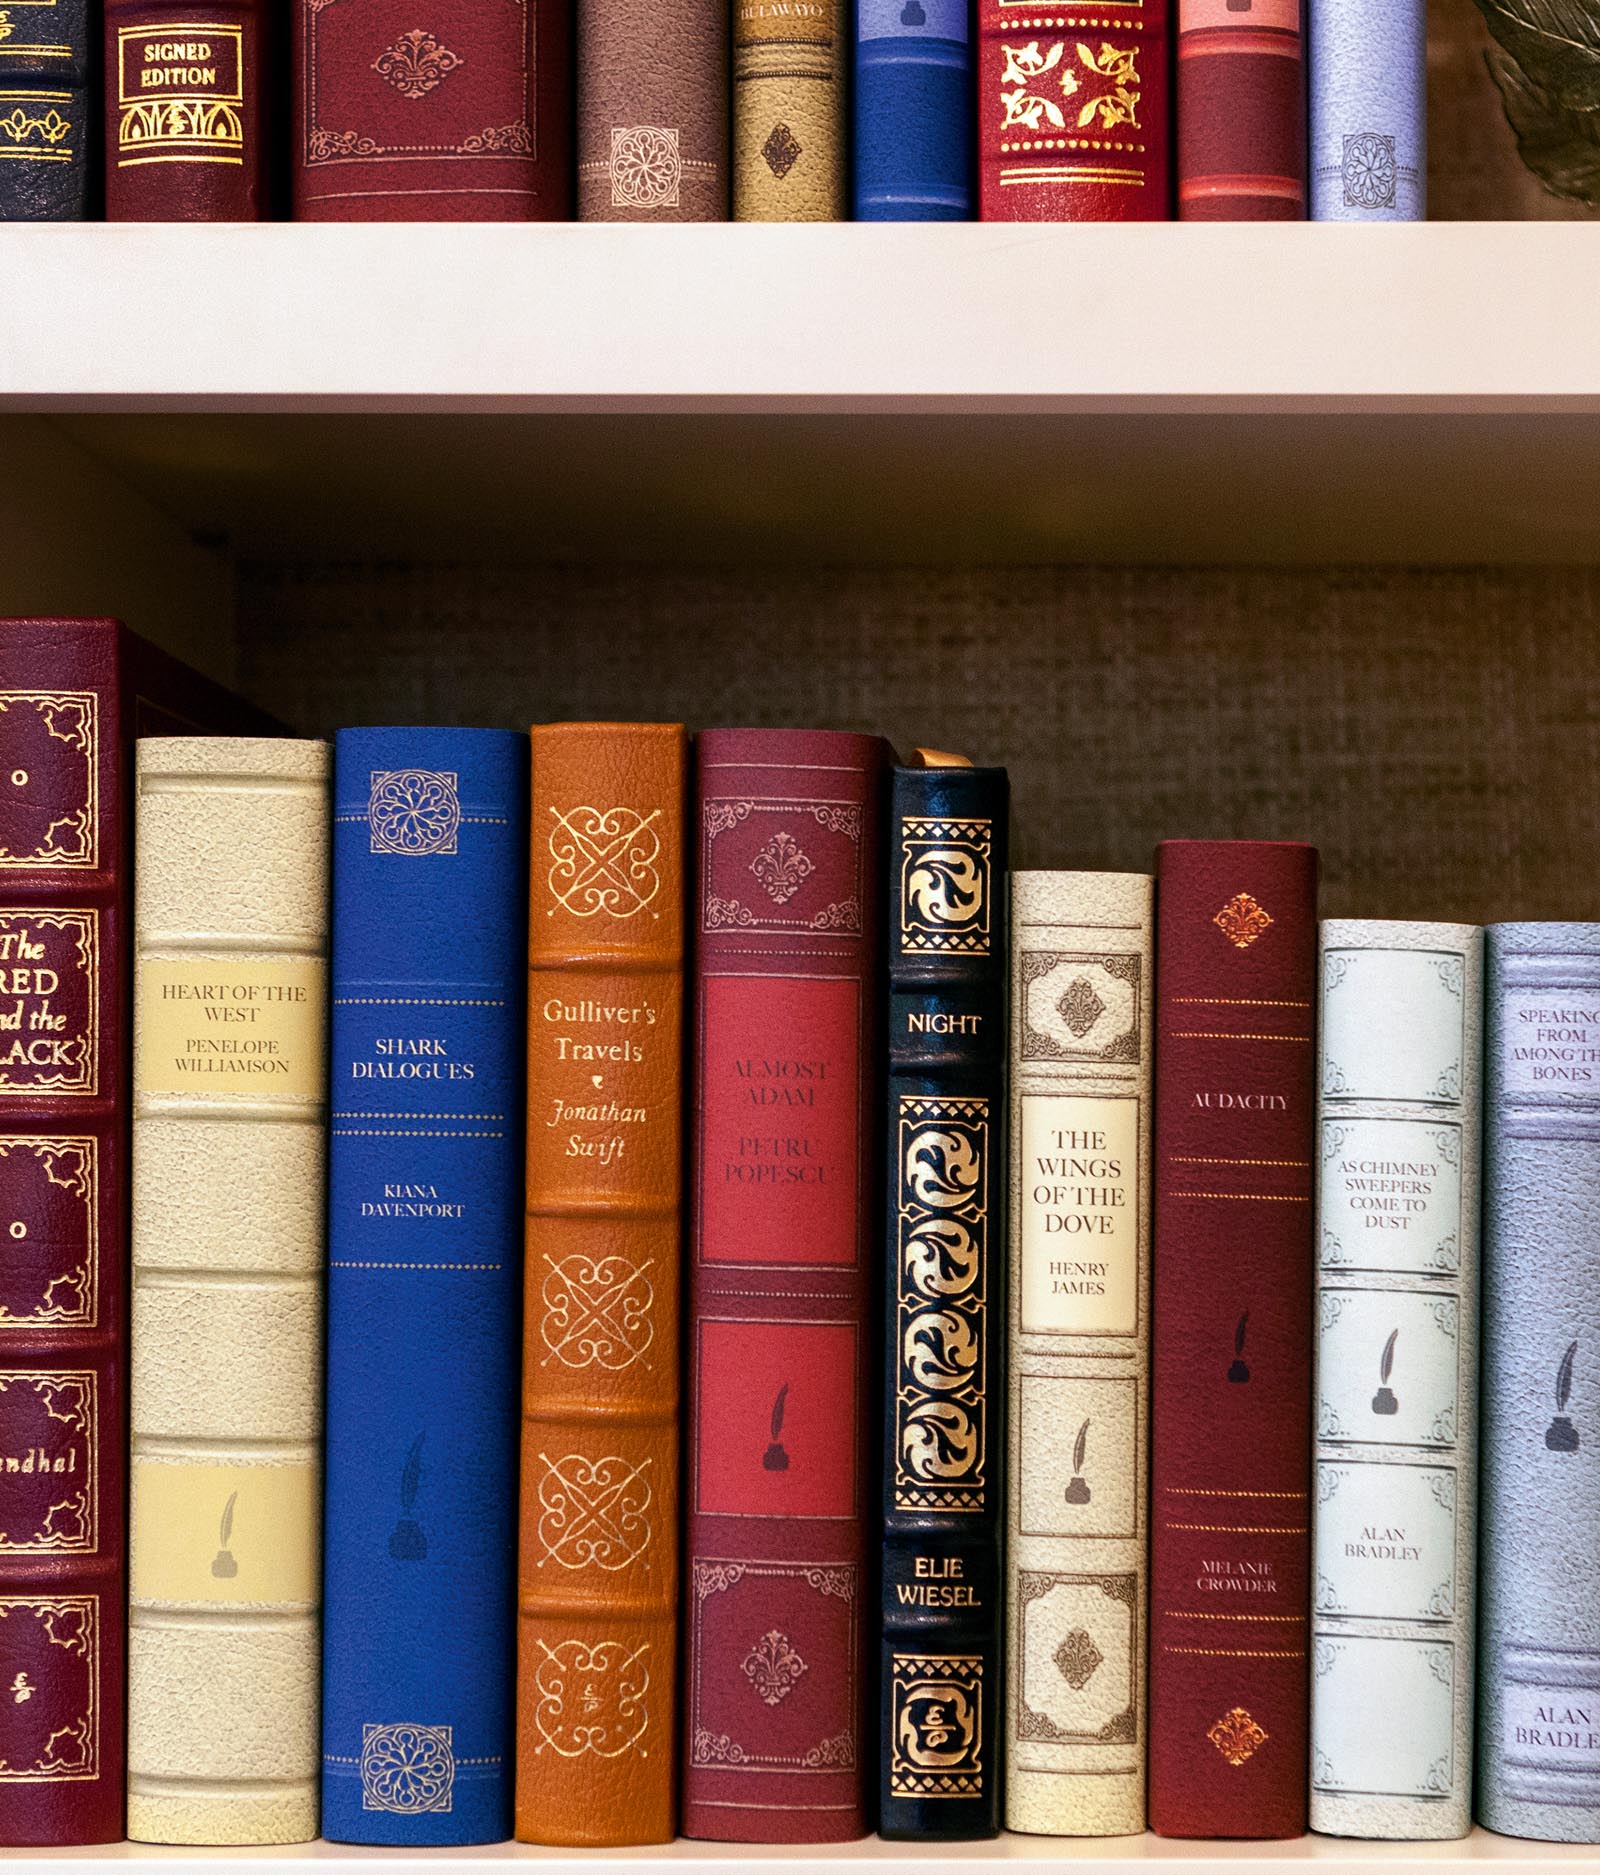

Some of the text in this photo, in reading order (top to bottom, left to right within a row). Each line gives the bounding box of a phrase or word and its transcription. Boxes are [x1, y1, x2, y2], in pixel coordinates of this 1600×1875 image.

[144, 43, 212, 63] SIGNED
[141, 67, 216, 87] EDITION
[0, 929, 46, 961] The
[162, 984, 308, 1002] HEART OF THE
[29, 999, 68, 1031] the
[204, 1007, 261, 1023] WEST
[543, 999, 656, 1024] Gulliver's
[908, 1013, 982, 1034] NIGHT
[1537, 1028, 1589, 1043] FROM
[186, 1039, 279, 1054] PENELOPE
[375, 1038, 447, 1056] SHARK
[554, 1037, 643, 1062] Travels
[1510, 1047, 1575, 1062] AMONG
[175, 1058, 290, 1074] WILLIAMSON
[352, 1062, 475, 1080] DIALOGUES
[734, 1060, 830, 1080] ALMOST
[1533, 1066, 1592, 1081] BONES
[748, 1087, 816, 1106] ADAM
[1191, 1093, 1289, 1110] AUDACITY
[546, 1099, 647, 1127] Jonathan
[740, 1137, 819, 1157] PETRU
[1051, 1130, 1107, 1150] THE
[565, 1134, 625, 1165] Swift
[725, 1163, 833, 1184] POPESCU
[1037, 1157, 1122, 1178] WINGS
[1337, 1160, 1440, 1177] AS CHIMNEY
[384, 1184, 438, 1199] KIANA
[1345, 1178, 1432, 1194] SWEEPERS
[1033, 1185, 1126, 1207] OF THE
[1350, 1196, 1427, 1212] COME TO
[361, 1202, 466, 1218] DAVENPORT
[1045, 1213, 1115, 1234] DOVE
[1365, 1215, 1411, 1229] DUST
[1049, 1261, 1110, 1276] HENRY
[1052, 1281, 1106, 1296] JAMES
[1360, 1527, 1406, 1541] ALAN
[1344, 1543, 1423, 1560] BRADLEY
[914, 1557, 964, 1579] ELIE
[1202, 1560, 1274, 1576] MELANIE
[1196, 1577, 1278, 1593] CROWDER
[896, 1584, 982, 1608] WIESEL
[1533, 1707, 1593, 1725] ALAN
